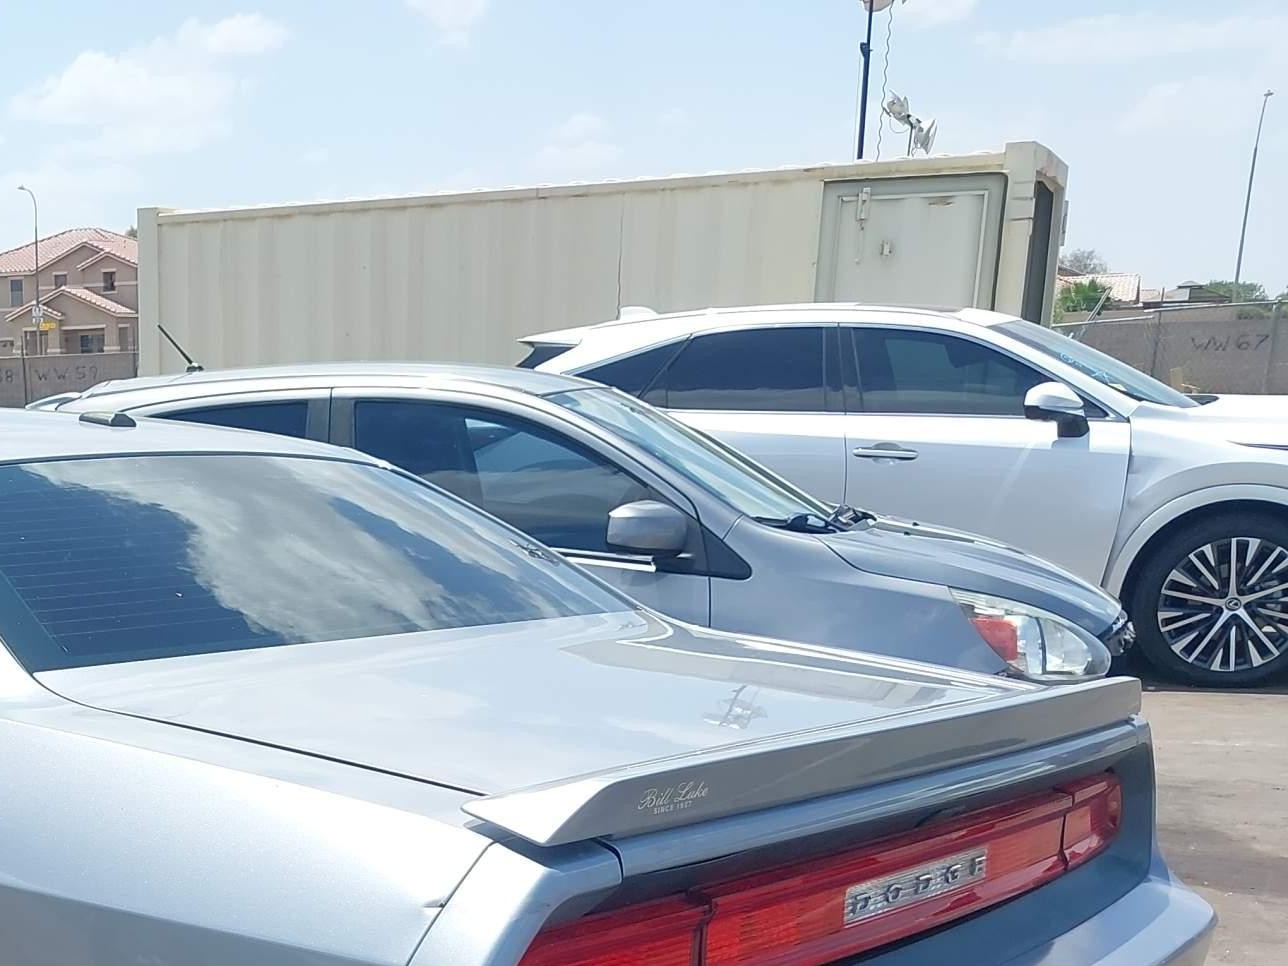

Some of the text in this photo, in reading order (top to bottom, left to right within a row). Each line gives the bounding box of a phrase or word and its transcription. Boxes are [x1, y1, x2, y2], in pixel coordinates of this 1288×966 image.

[1236, 333, 1270, 351] 67
[638, 787, 674, 810] Bill
[849, 855, 987, 916] DODGE
